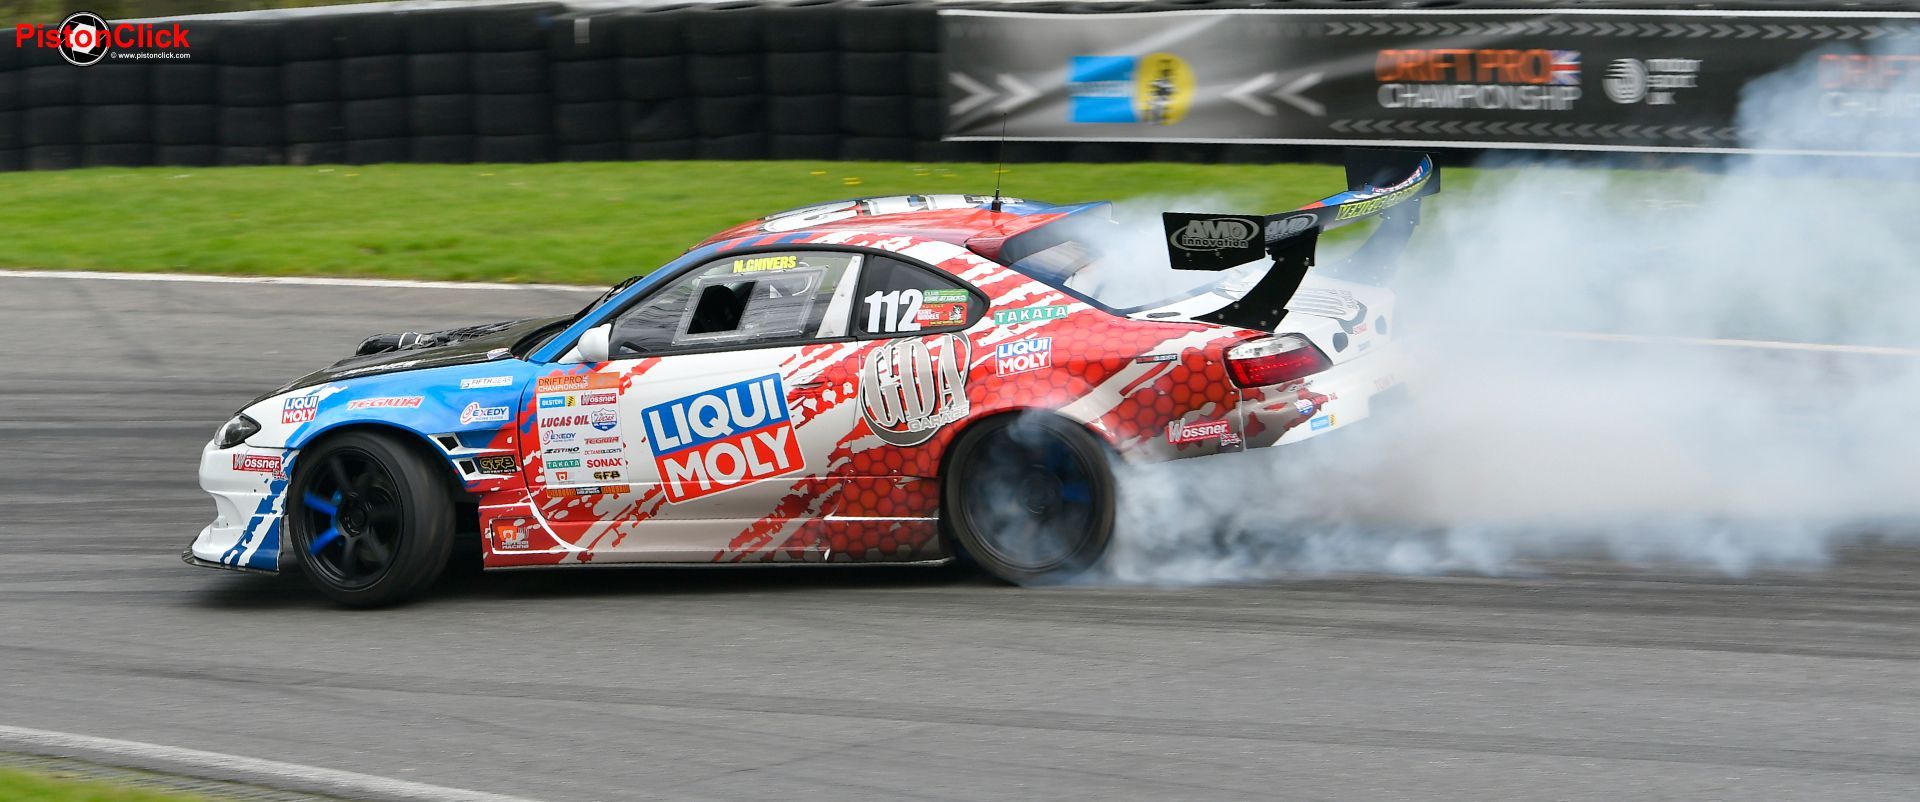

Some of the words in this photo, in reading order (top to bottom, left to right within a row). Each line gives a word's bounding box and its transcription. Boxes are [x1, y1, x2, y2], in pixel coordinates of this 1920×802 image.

[1185, 219, 1248, 240] AMD
[1181, 234, 1249, 249] innovation
[864, 288, 924, 333] 112
[996, 307, 1066, 323] TAKATA
[1000, 340, 1050, 359] LIQUI
[999, 354, 1050, 374] MOLY
[538, 378, 562, 386] DRIFT
[564, 375, 583, 384] PRO
[539, 382, 589, 392] CHAMPIONSHIP
[863, 333, 969, 428] GDA
[285, 396, 317, 412] LIQUI
[283, 408, 316, 422] MOLY
[473, 408, 507, 416] EXEDY
[648, 378, 782, 452] LIQUI
[541, 416, 572, 428] LUCAS
[574, 415, 590, 426] OIL
[480, 457, 515, 470] GFB
[548, 460, 580, 468] TAKATA
[587, 458, 622, 468] SONAX
[663, 425, 791, 498] MOLY
[594, 471, 620, 480] GFB
